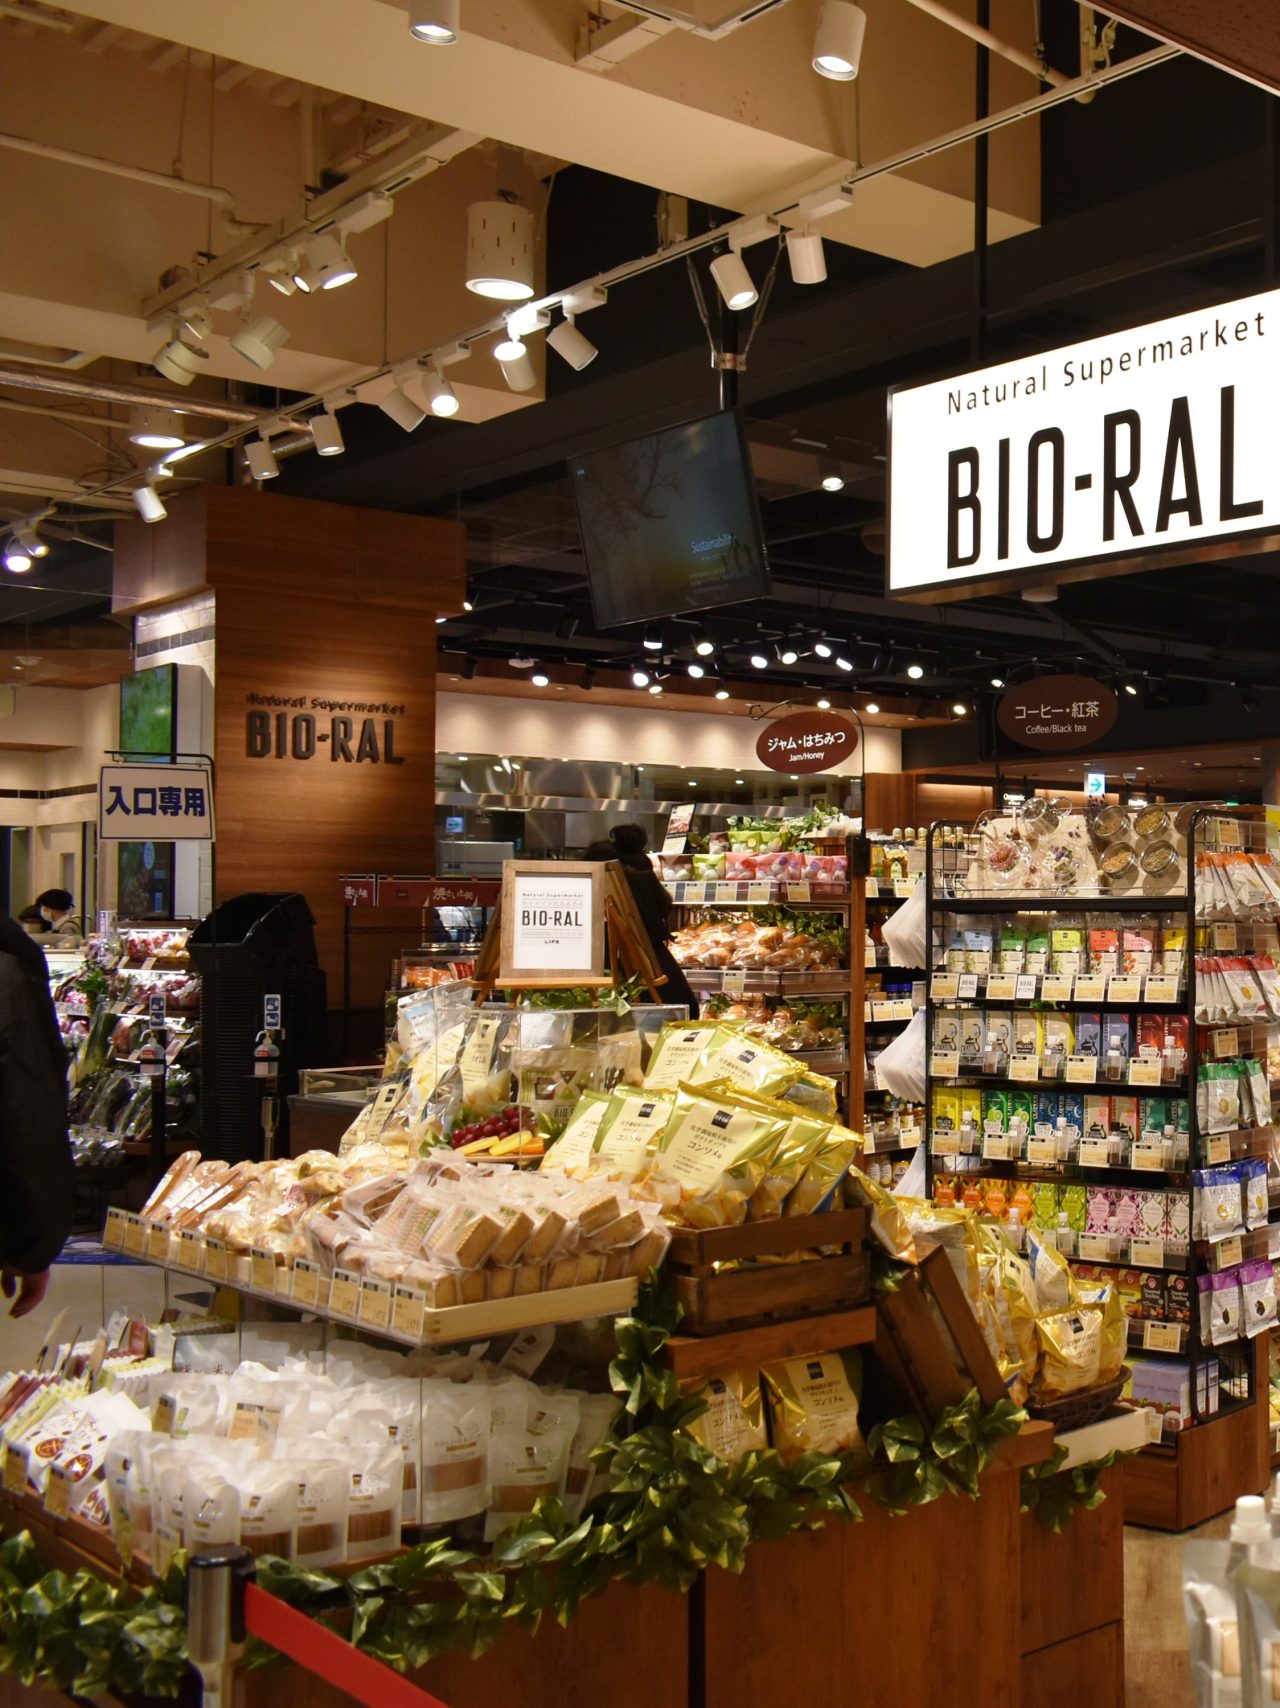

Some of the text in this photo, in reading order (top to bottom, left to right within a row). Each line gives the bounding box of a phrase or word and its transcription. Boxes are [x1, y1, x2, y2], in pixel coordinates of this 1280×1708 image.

[948, 311, 1266, 415] Natural Supermarket
[947, 385, 1264, 569] BIO-RAL
[1015, 701, 1100, 719] コーヒー・紅茶
[246, 710, 405, 764] BIO-RAL
[767, 731, 846, 751] ジャム・はちみつ
[788, 751, 824, 762] Jam/Honey
[105, 786, 205, 817] 入口専用
[522, 910, 583, 926] BIO-RAL
